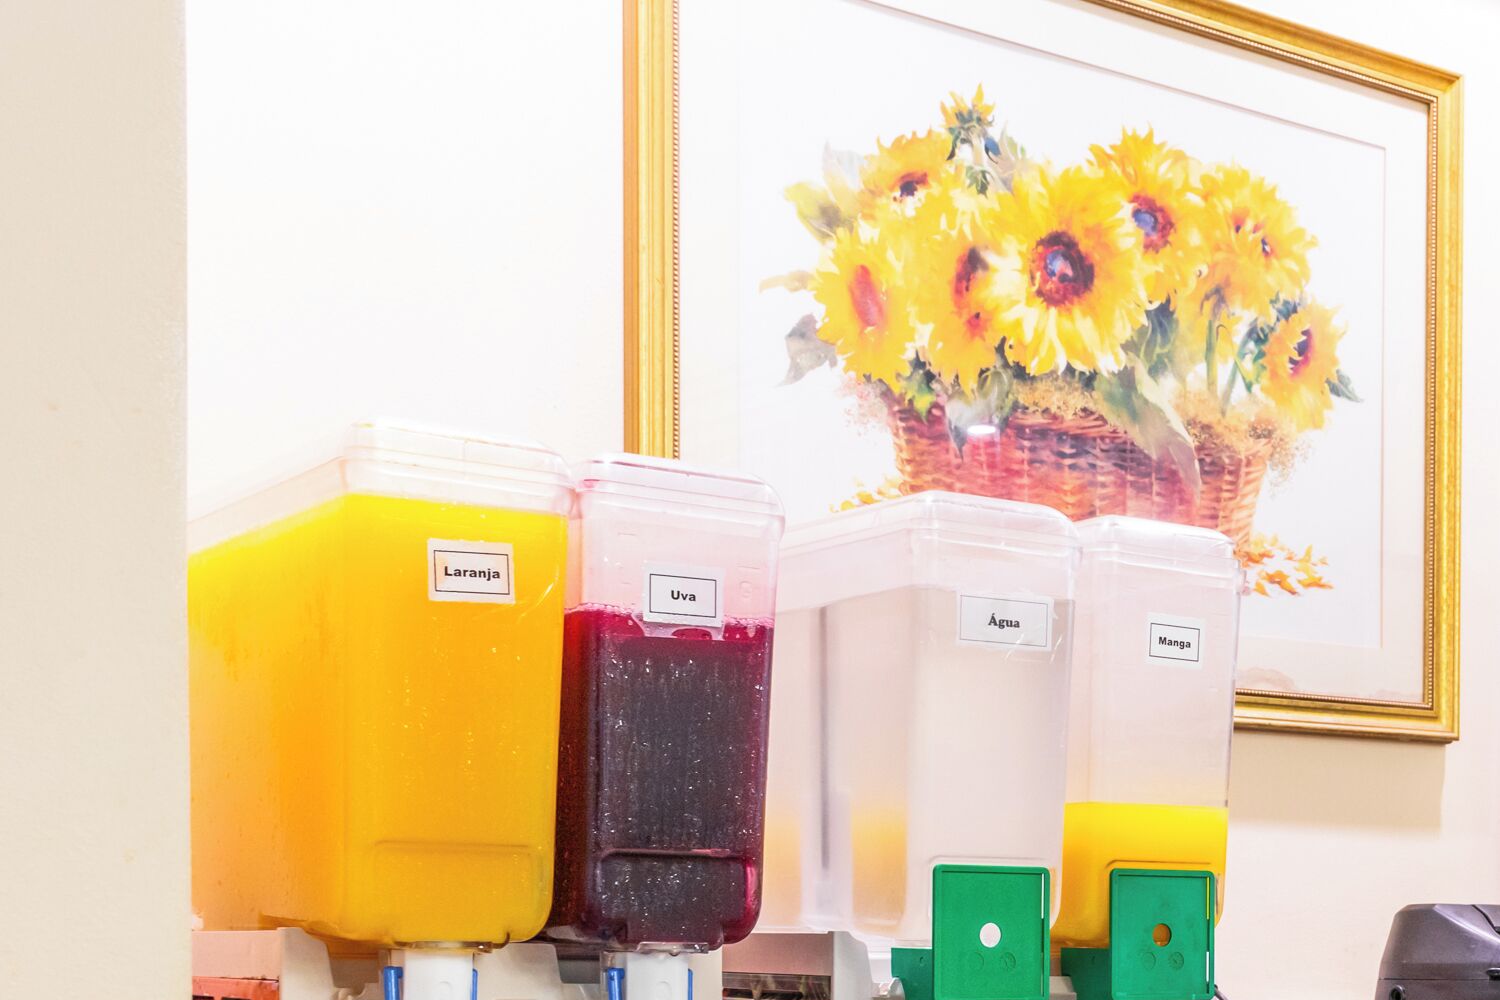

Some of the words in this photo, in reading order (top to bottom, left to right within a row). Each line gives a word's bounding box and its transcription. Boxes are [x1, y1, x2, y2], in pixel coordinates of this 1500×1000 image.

[444, 565, 501, 582] Laranja
[670, 589, 697, 602] Uva
[988, 612, 1021, 629] Água
[1158, 636, 1192, 649] Manga
